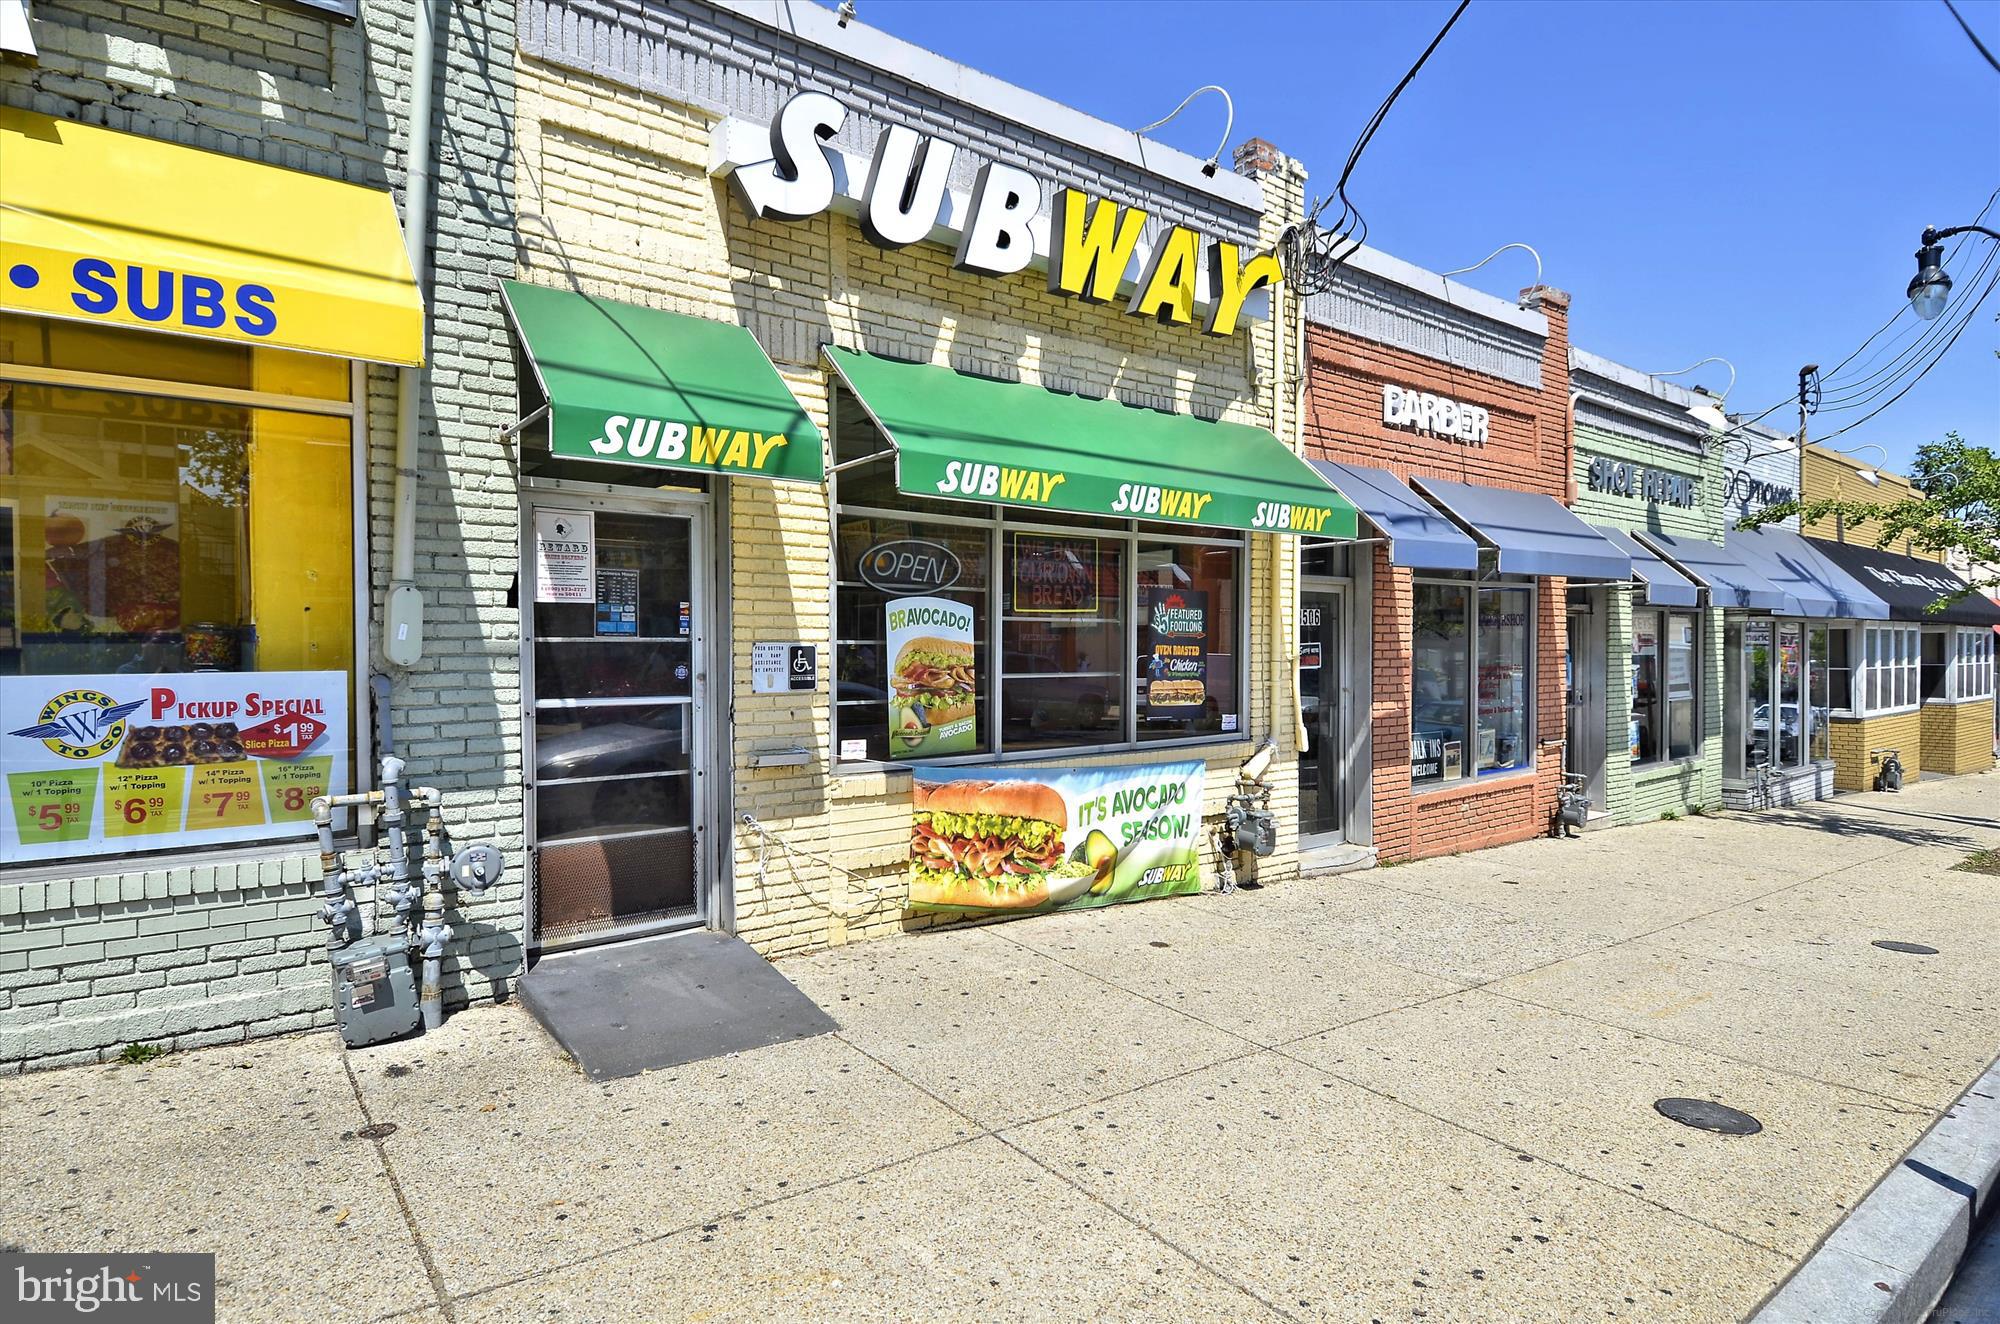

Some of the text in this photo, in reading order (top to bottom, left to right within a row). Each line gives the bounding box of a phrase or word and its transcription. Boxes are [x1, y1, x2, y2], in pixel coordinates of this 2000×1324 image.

[731, 90, 1284, 337] SUBWAY
[71, 258, 278, 336] SUBS
[1382, 383, 1490, 444] BARBER
[589, 415, 788, 469] SUBWAY
[936, 460, 1067, 502] SUBWAY
[1589, 456, 1695, 507] SHOE REPAIR
[1111, 483, 1213, 519] SUBWAY
[1251, 501, 1331, 533] SUBWAY
[539, 543, 588, 553] REWARD
[874, 550, 948, 584] OPEN
[1032, 585, 1084, 605] BREAD
[889, 607, 971, 632] BRAVOCADO!
[1170, 608, 1203, 620] FEATURED
[1300, 609, 1320, 625] 506
[1170, 621, 1203, 632] FOOTLONG
[1155, 644, 1200, 656] OVEN ROASTED
[1170, 658, 1199, 672] Chicken
[41, 692, 111, 720] WINGS
[58, 725, 122, 757] TO GO
[939, 723, 973, 740] AVOCADO
[245, 738, 289, 749] Slice Pizza
[290, 772, 321, 781] Topping
[294, 764, 314, 772] Pizza
[1412, 762, 1438, 777] WELCOME
[49, 779, 74, 787] Pizza
[131, 782, 166, 791] Topping
[219, 776, 251, 786] Topping
[44, 787, 82, 797] Topping
[1078, 781, 1186, 827] IT'S AVOCADO
[1120, 813, 1191, 848] SEASON!
[1137, 860, 1193, 888] SUBWAY
